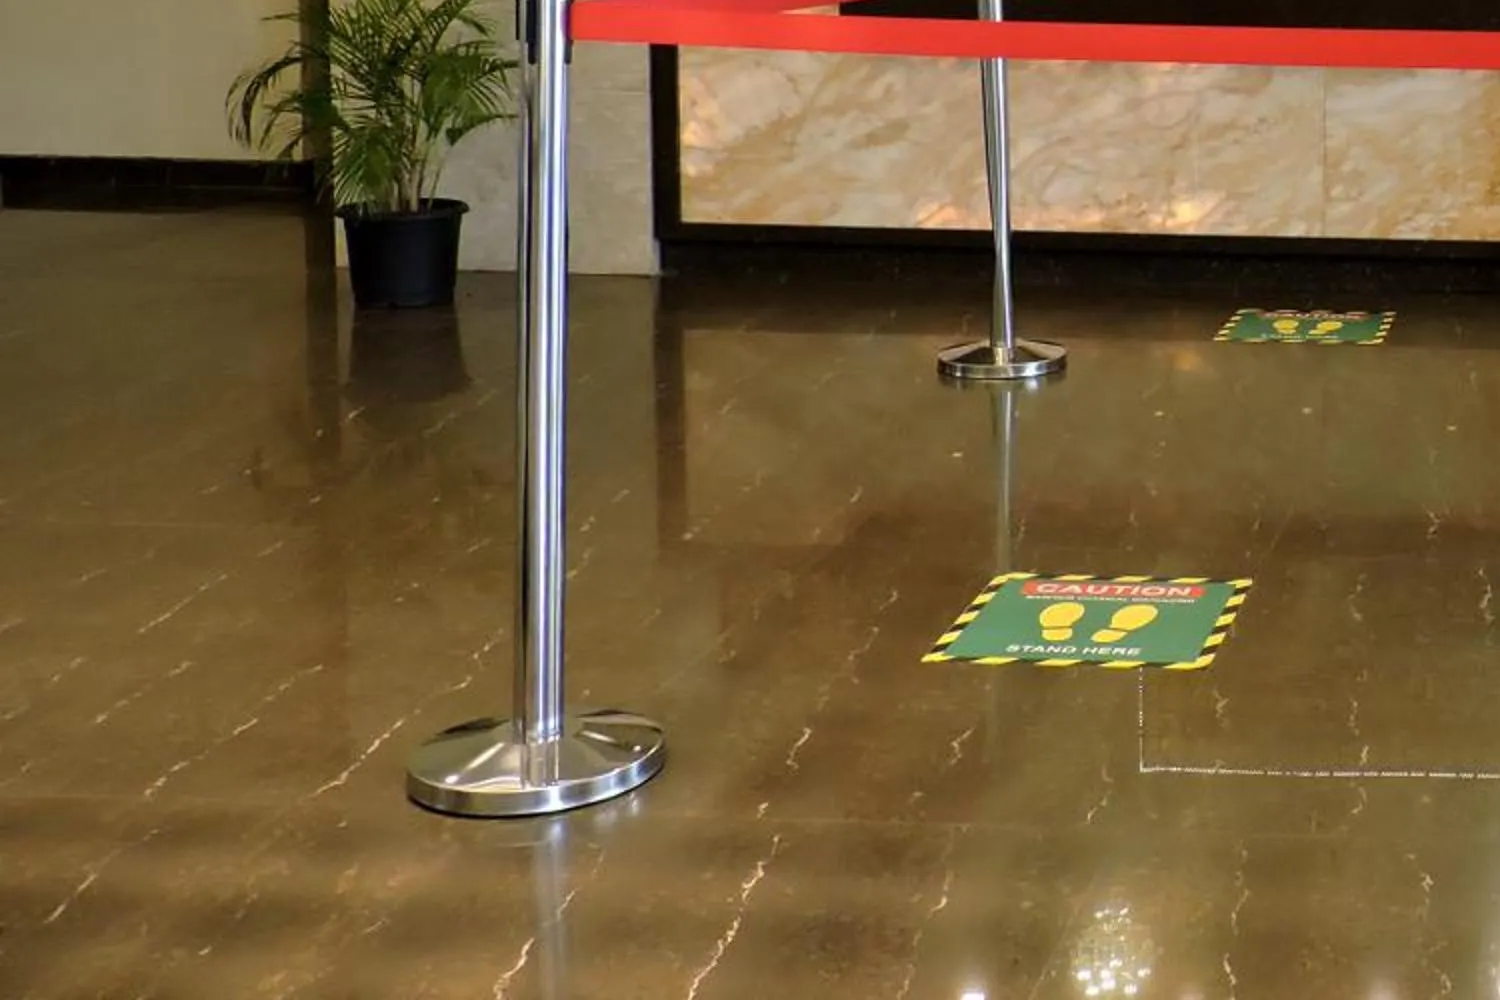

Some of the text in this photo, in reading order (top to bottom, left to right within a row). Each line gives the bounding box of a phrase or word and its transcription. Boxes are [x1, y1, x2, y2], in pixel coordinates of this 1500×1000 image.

[1035, 582, 1193, 597] CAUTION
[1005, 644, 1142, 656] STAND HERE
